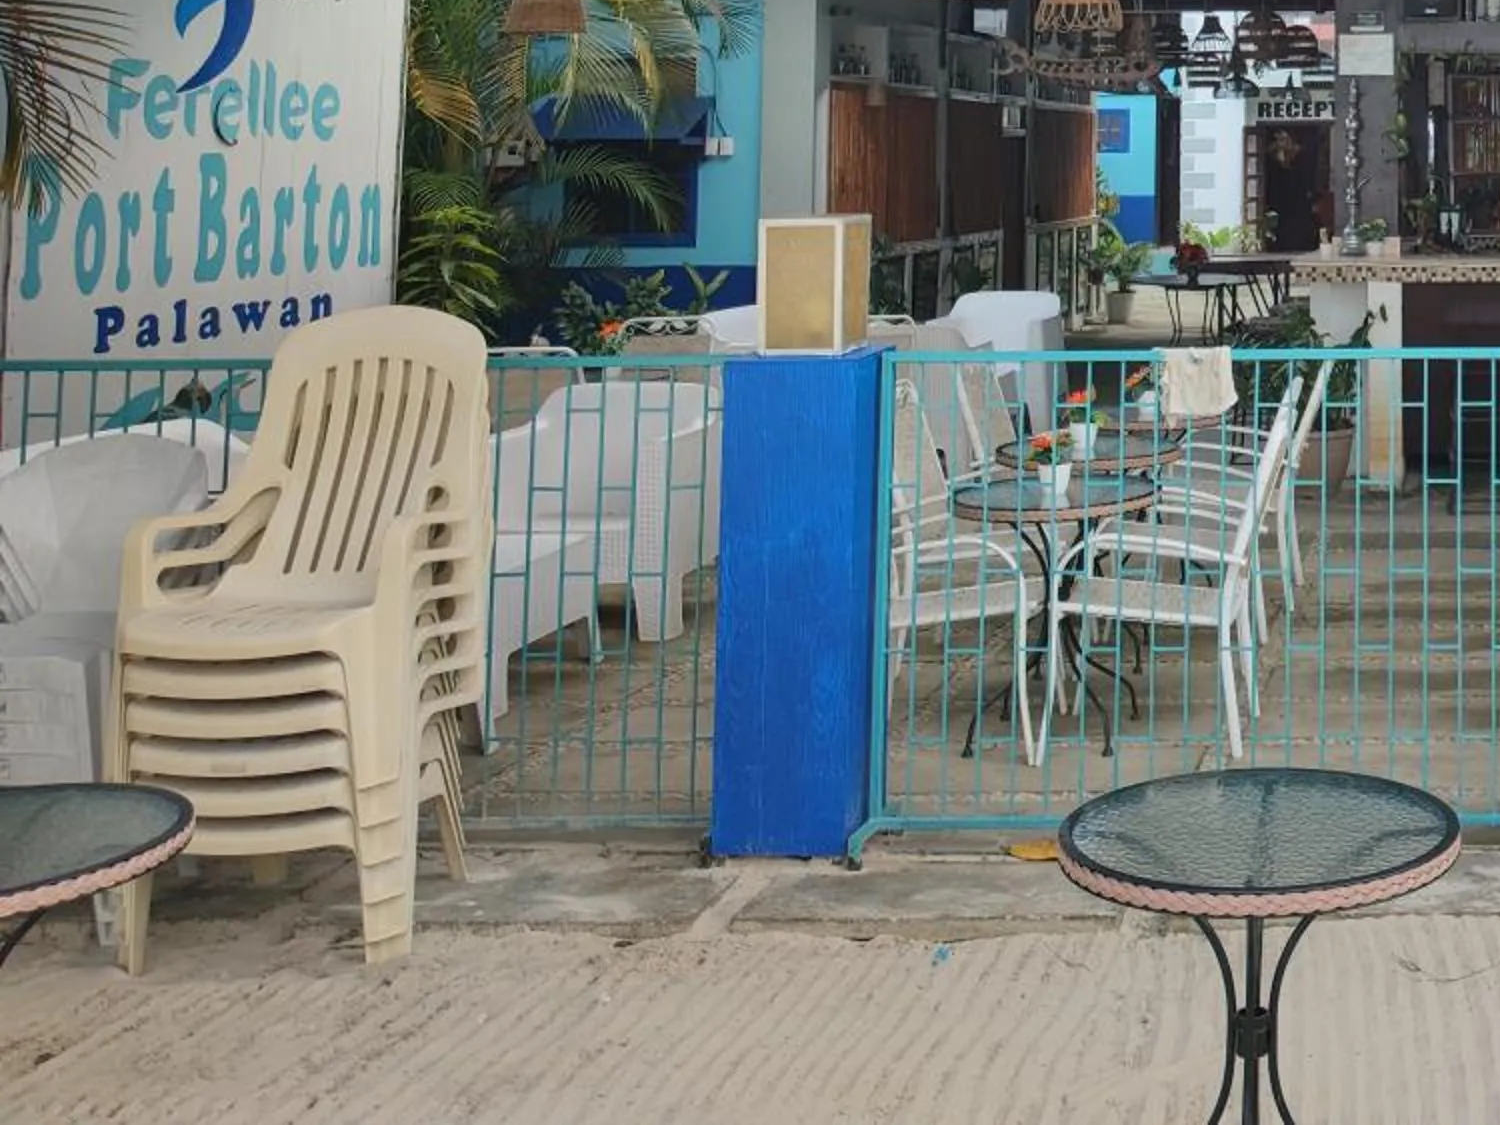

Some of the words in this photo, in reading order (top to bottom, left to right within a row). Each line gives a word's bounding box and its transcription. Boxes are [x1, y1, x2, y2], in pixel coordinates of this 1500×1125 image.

[106, 57, 341, 141] Ferellee
[19, 148, 176, 301] Port
[192, 151, 382, 284] Barton
[93, 291, 333, 355] Palawan
